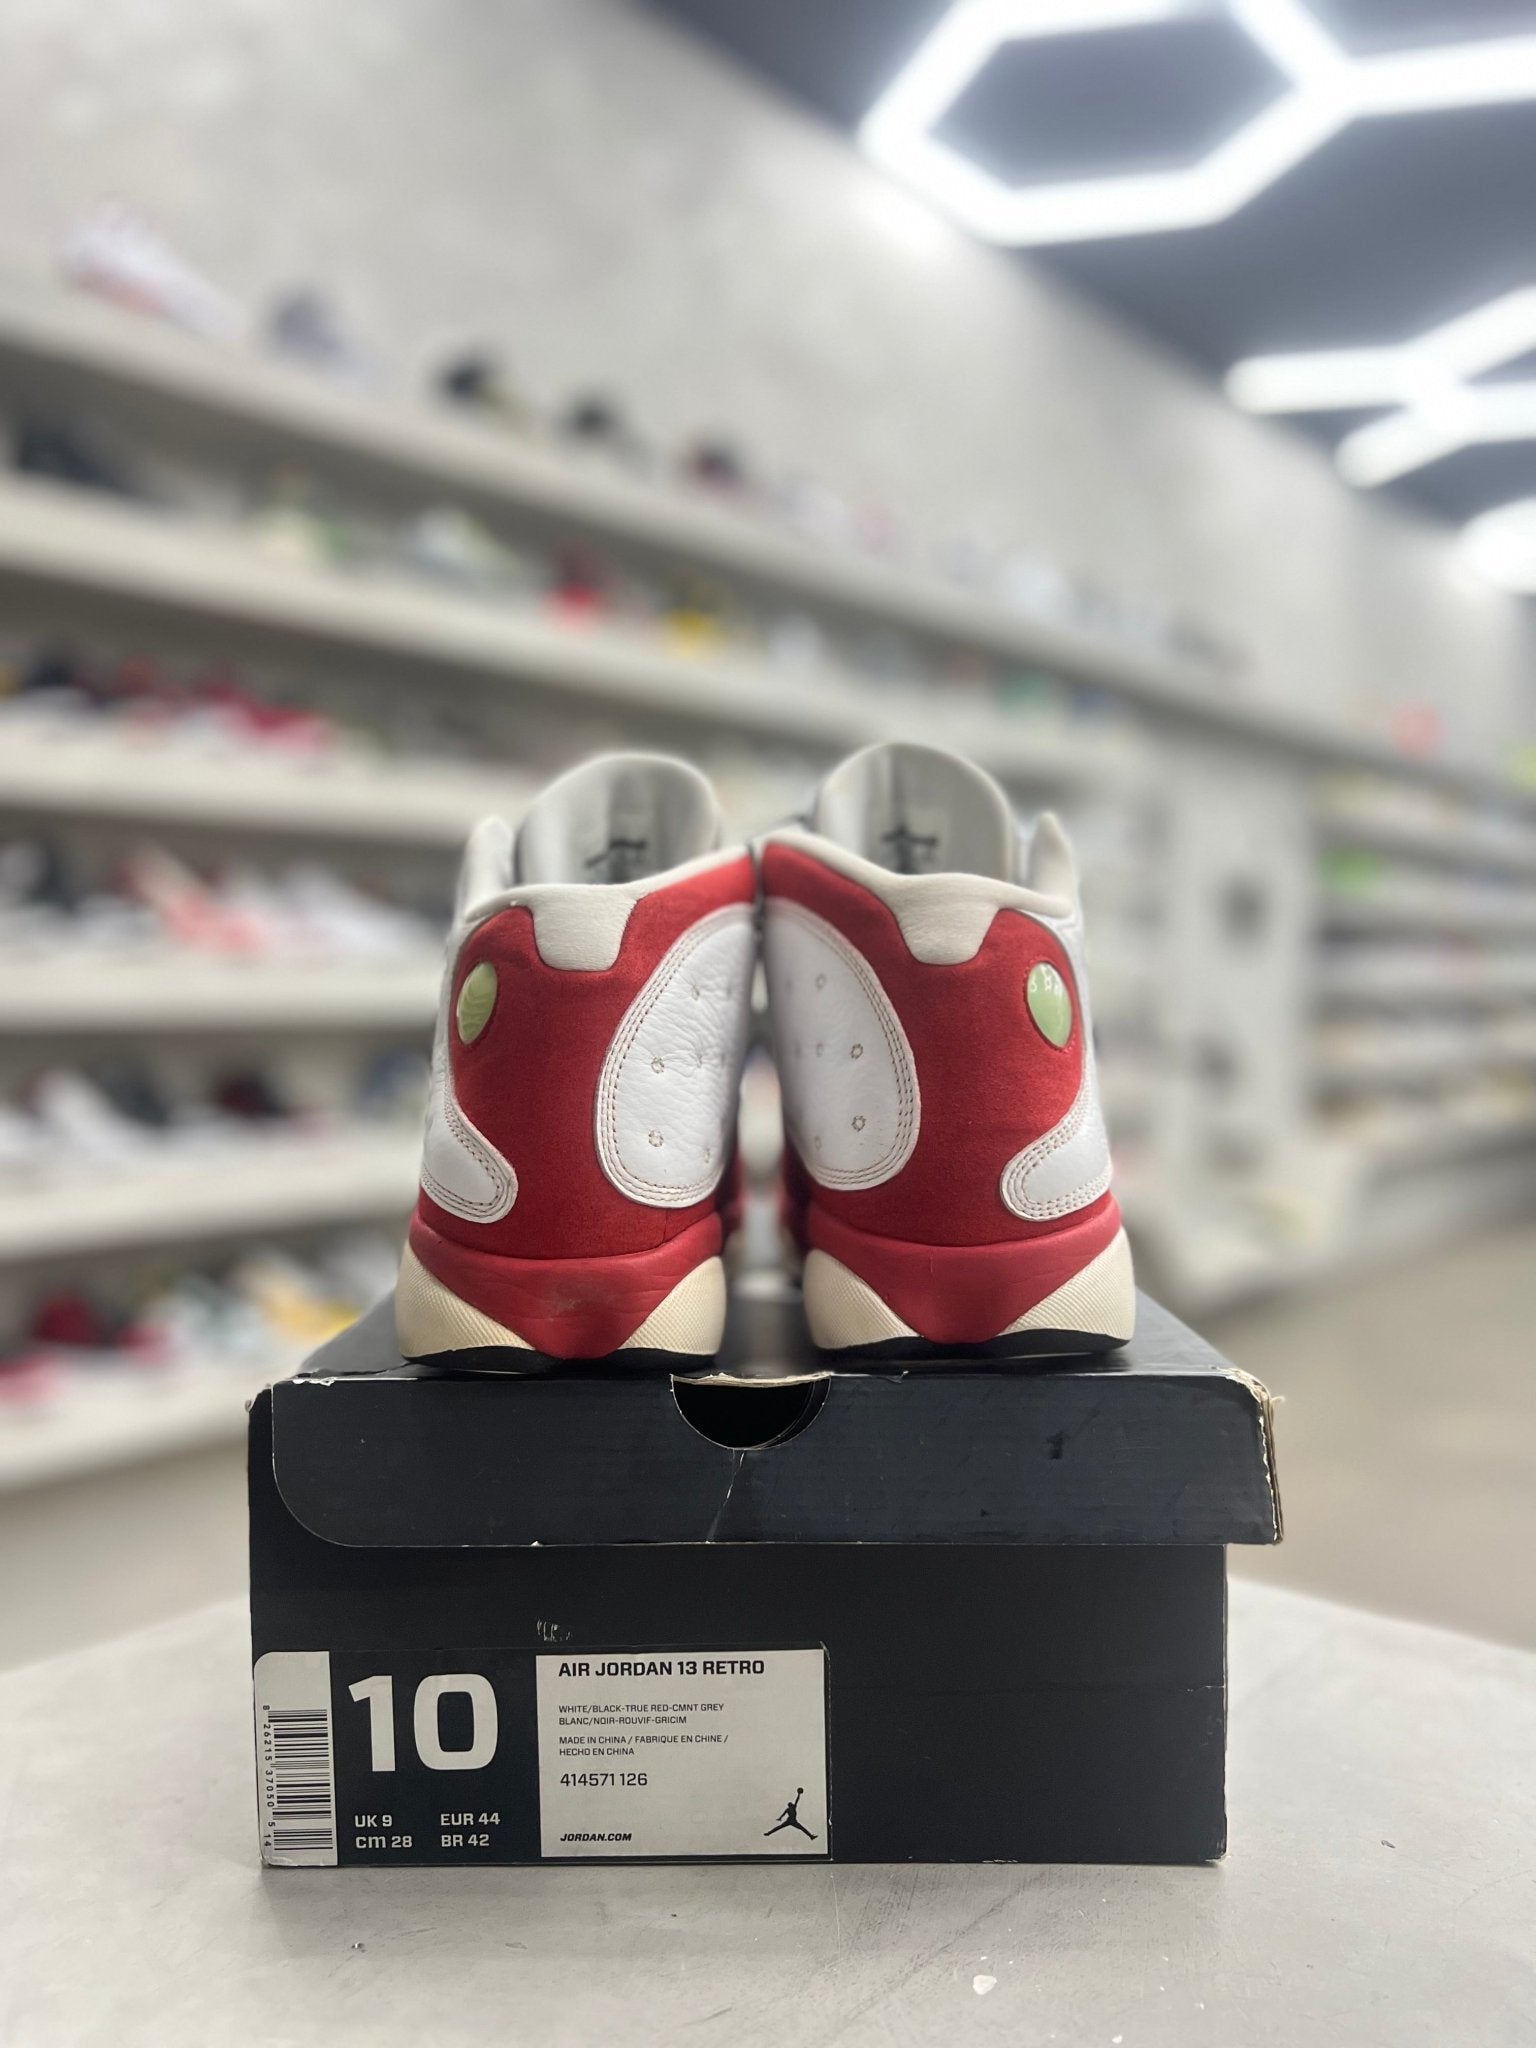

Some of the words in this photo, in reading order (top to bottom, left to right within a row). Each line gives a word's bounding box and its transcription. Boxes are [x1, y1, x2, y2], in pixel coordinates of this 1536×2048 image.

[558, 1662, 590, 1678] AIR
[594, 1661, 673, 1677] JORDAN
[677, 1660, 698, 1676] 13
[702, 1659, 765, 1676] RETRO
[558, 1704, 649, 1714] WHITE/BLACK-TRUE
[650, 1703, 699, 1713] RED-CMNT
[700, 1703, 725, 1712] GREY
[348, 1673, 499, 1772] 10
[558, 1715, 687, 1726] BLANC/NOIR-ROUVIF-GRICIM
[263, 1723, 273, 1761] 26215
[558, 1736, 586, 1745] MADE
[586, 1736, 597, 1744] IN
[598, 1735, 627, 1744] CHINA
[634, 1735, 679, 1744] FABRIQUE
[680, 1735, 693, 1743] EN
[694, 1734, 723, 1743] CHINE
[559, 1747, 591, 1757] HECHO
[592, 1747, 605, 1756] EN
[606, 1747, 635, 1756] CHINA
[560, 1772, 615, 1787] 414571
[619, 1772, 648, 1787] 126
[265, 1769, 275, 1808] 37050
[354, 1814, 378, 1828] UK
[381, 1814, 393, 1827] 9
[440, 1812, 474, 1826] EUR
[478, 1812, 501, 1826] 44
[391, 1835, 413, 1848] 28
[440, 1834, 464, 1848] BR
[467, 1833, 490, 1847] 42
[559, 1832, 633, 1842] JORDAN.COM
